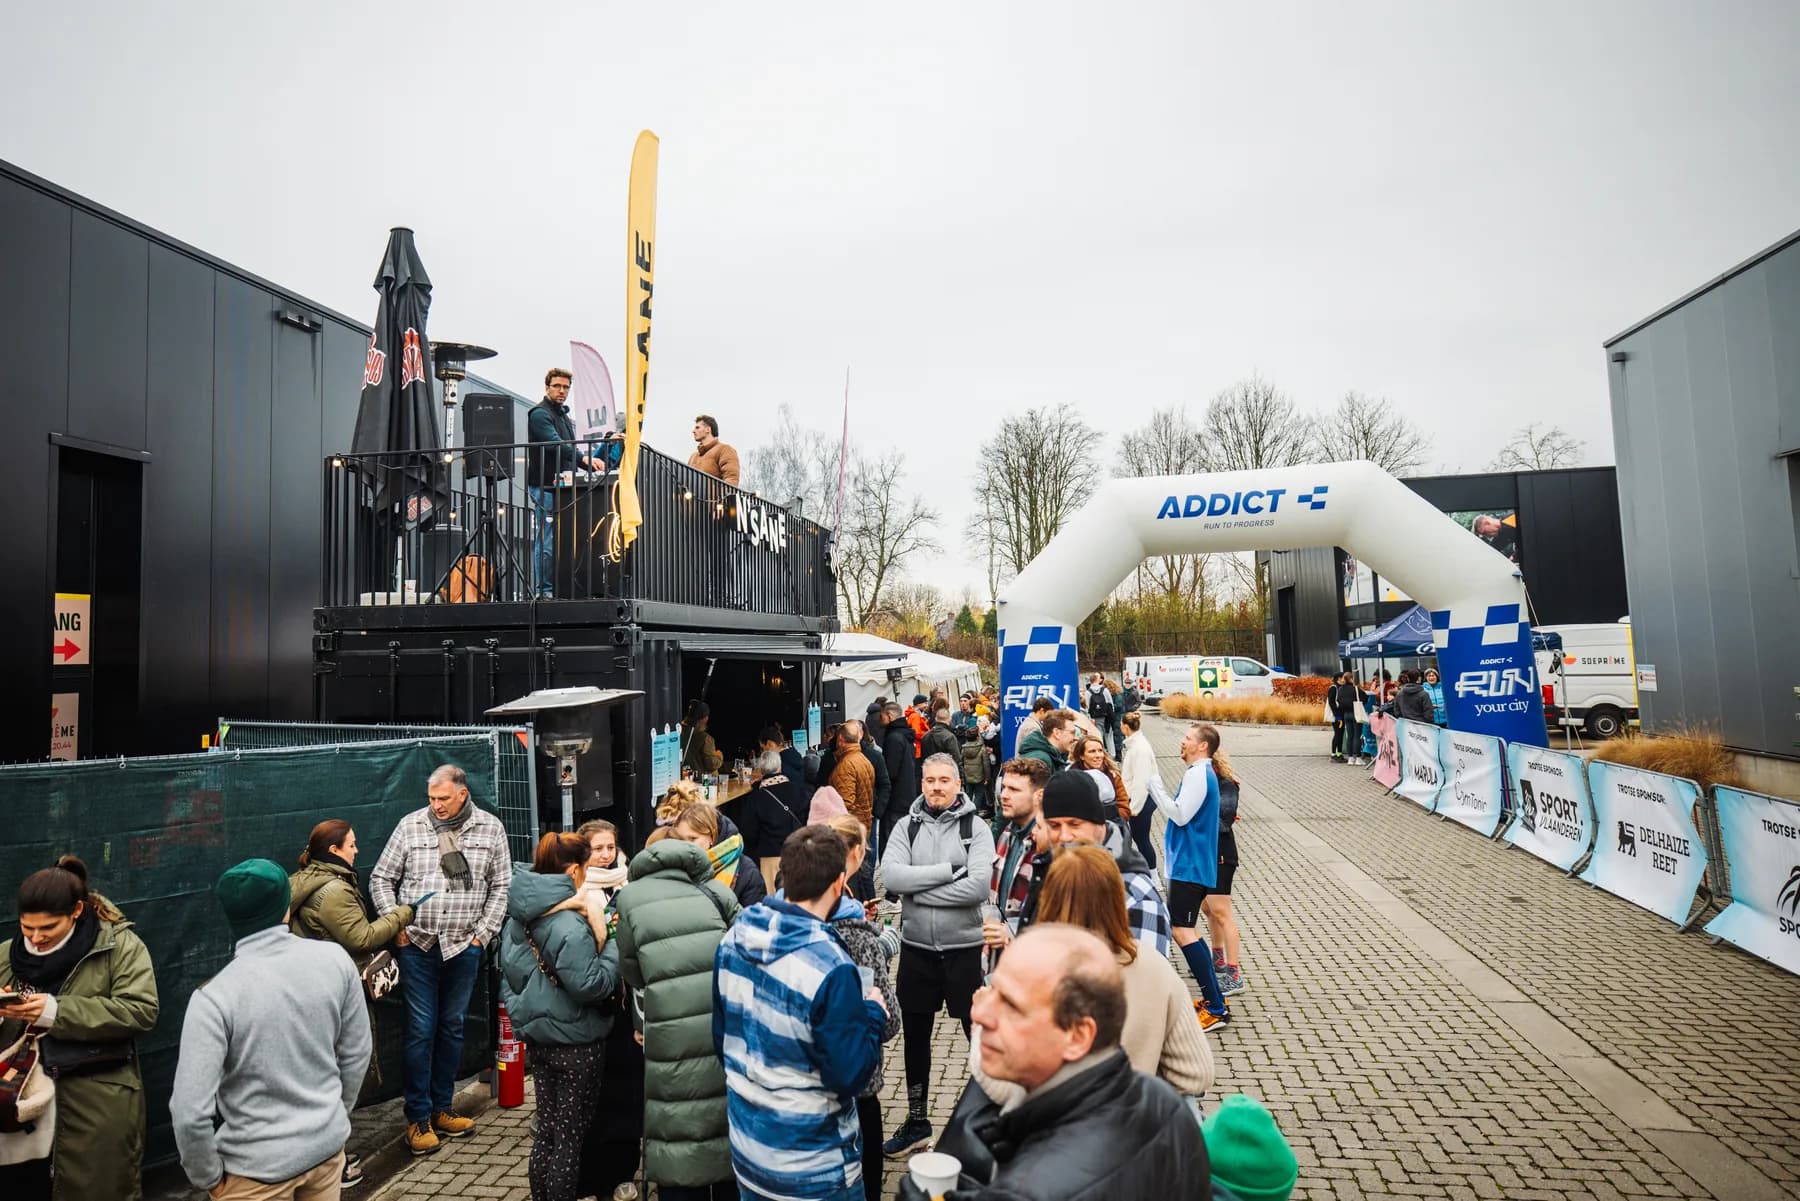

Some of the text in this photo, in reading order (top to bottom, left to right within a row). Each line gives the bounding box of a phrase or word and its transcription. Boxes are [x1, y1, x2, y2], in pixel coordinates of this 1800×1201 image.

[1157, 488, 1286, 519] ADDICT
[736, 491, 787, 554] N'SANE
[1203, 519, 1274, 530] RUN TO PROGRESS
[1480, 657, 1506, 665] ADDICT
[1455, 666, 1534, 698] RUN
[1474, 699, 1529, 717] your city
[1414, 765, 1438, 785] MARULA
[1617, 784, 1636, 797] TROTSE
[1540, 816, 1583, 842] VLAANDEREN
[1761, 819, 1797, 839] TROTSE
[1639, 826, 1690, 857] DELHAIZE
[1652, 852, 1678, 875] REET
